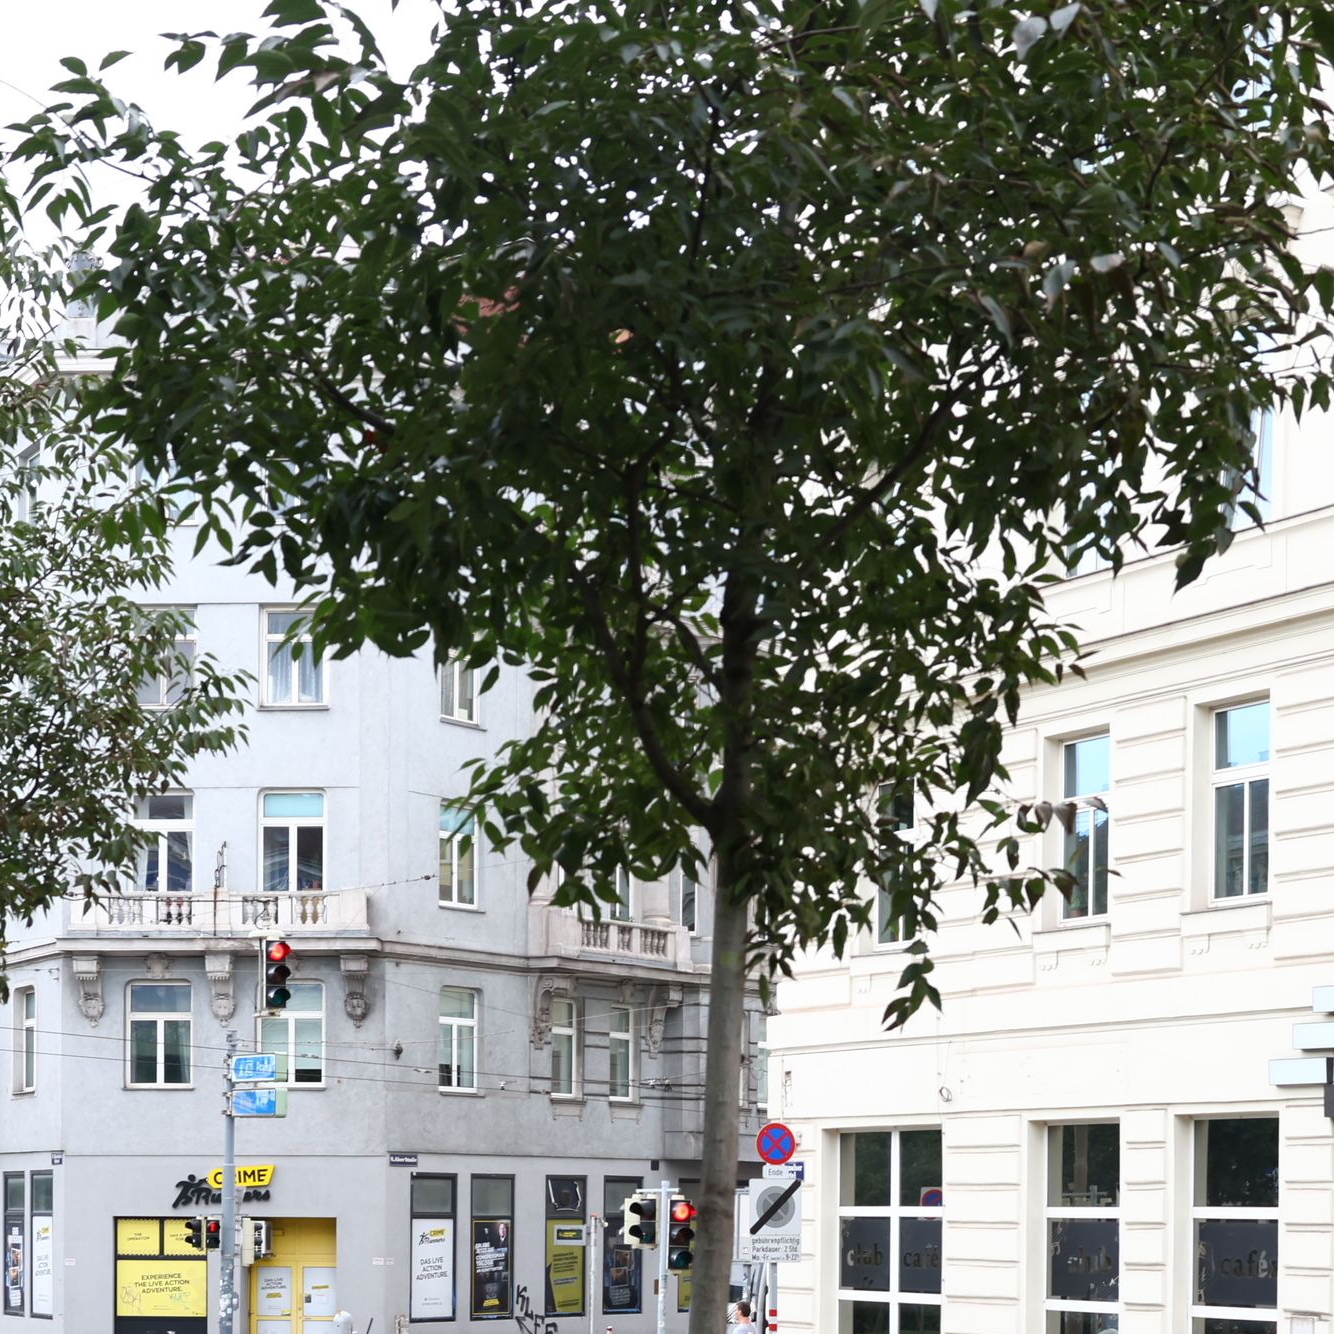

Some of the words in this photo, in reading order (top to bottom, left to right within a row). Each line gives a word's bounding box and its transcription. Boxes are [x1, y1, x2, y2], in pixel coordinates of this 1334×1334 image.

[214, 1169, 268, 1185] CIME
[141, 1273, 182, 1281] EXPERIENCE
[164, 1279, 190, 1287] ACTION
